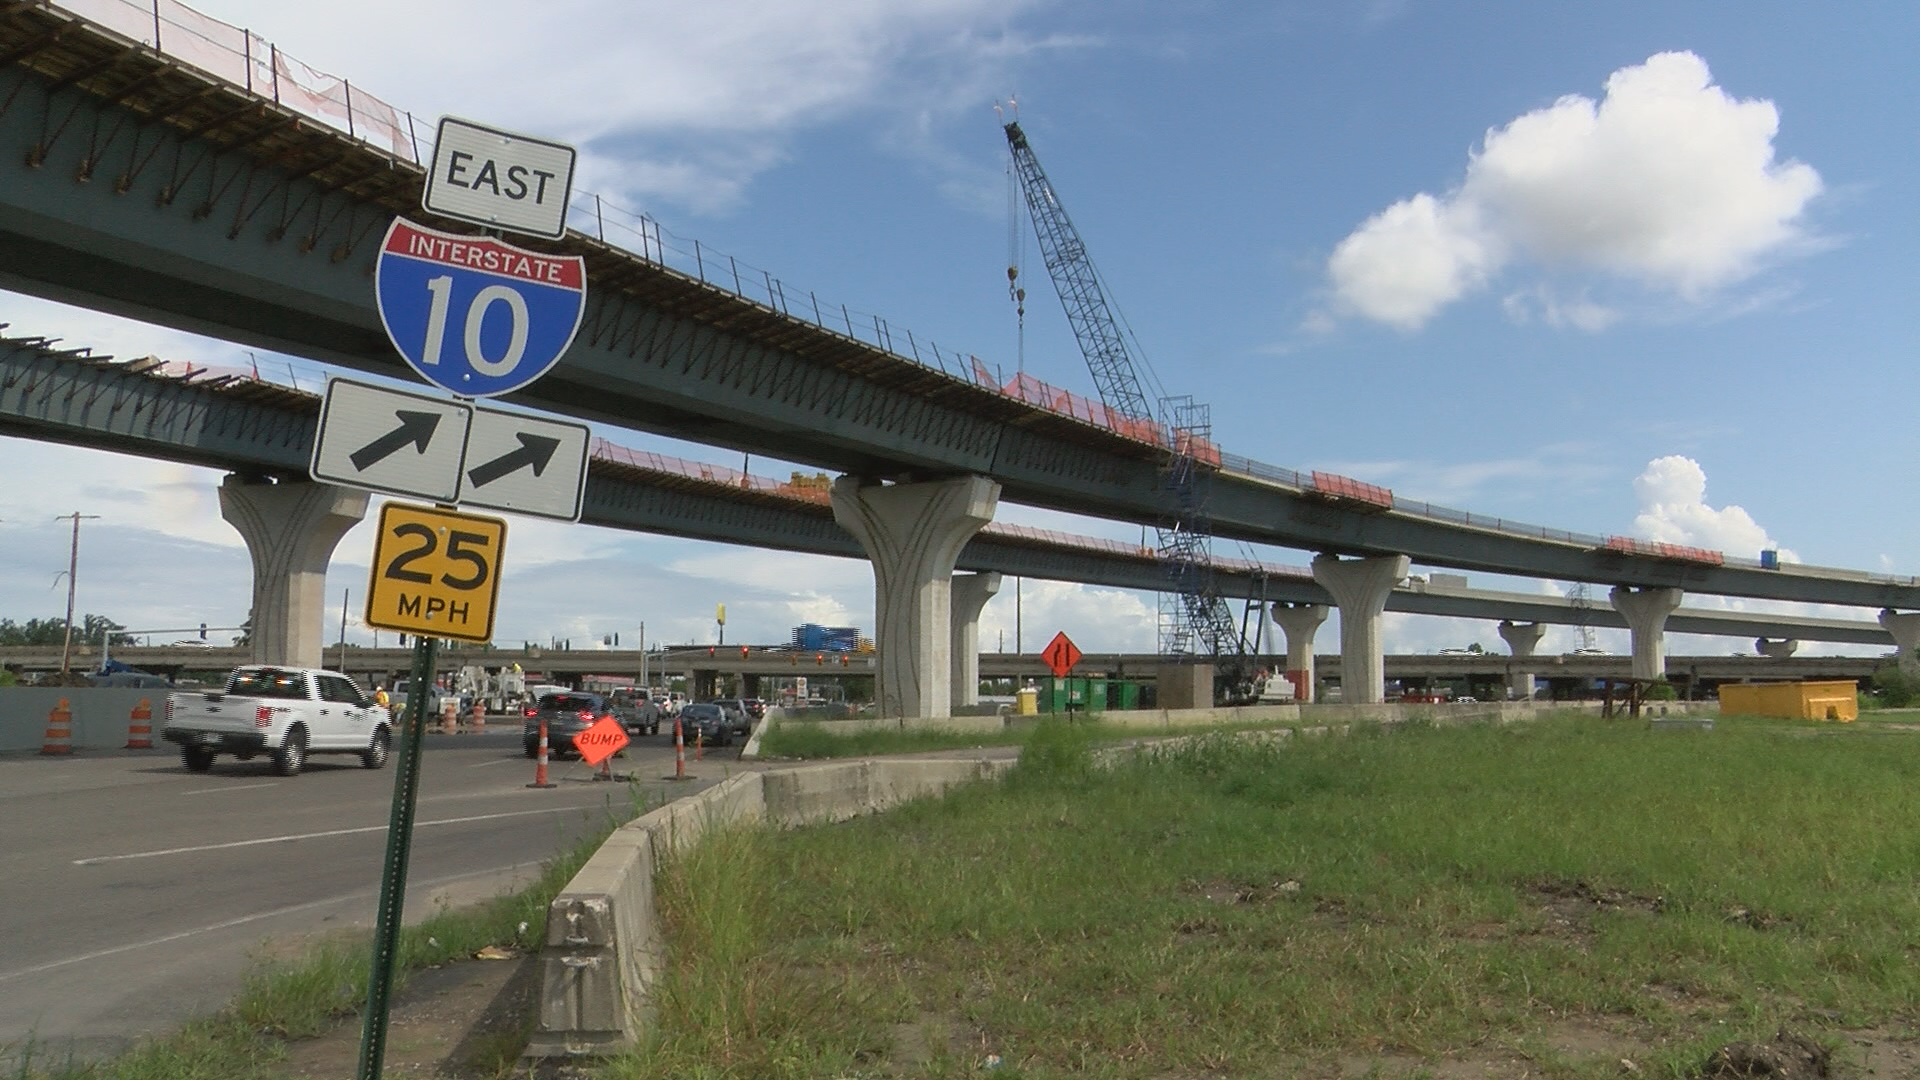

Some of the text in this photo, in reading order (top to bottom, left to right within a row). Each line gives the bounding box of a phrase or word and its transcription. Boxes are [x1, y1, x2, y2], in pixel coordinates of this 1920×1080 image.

[447, 150, 555, 205] EAST
[409, 234, 563, 282] INTERSTATE
[422, 274, 529, 378] 10
[385, 522, 489, 591] 25
[398, 592, 469, 625] MPH
[580, 732, 623, 746] BUMP
